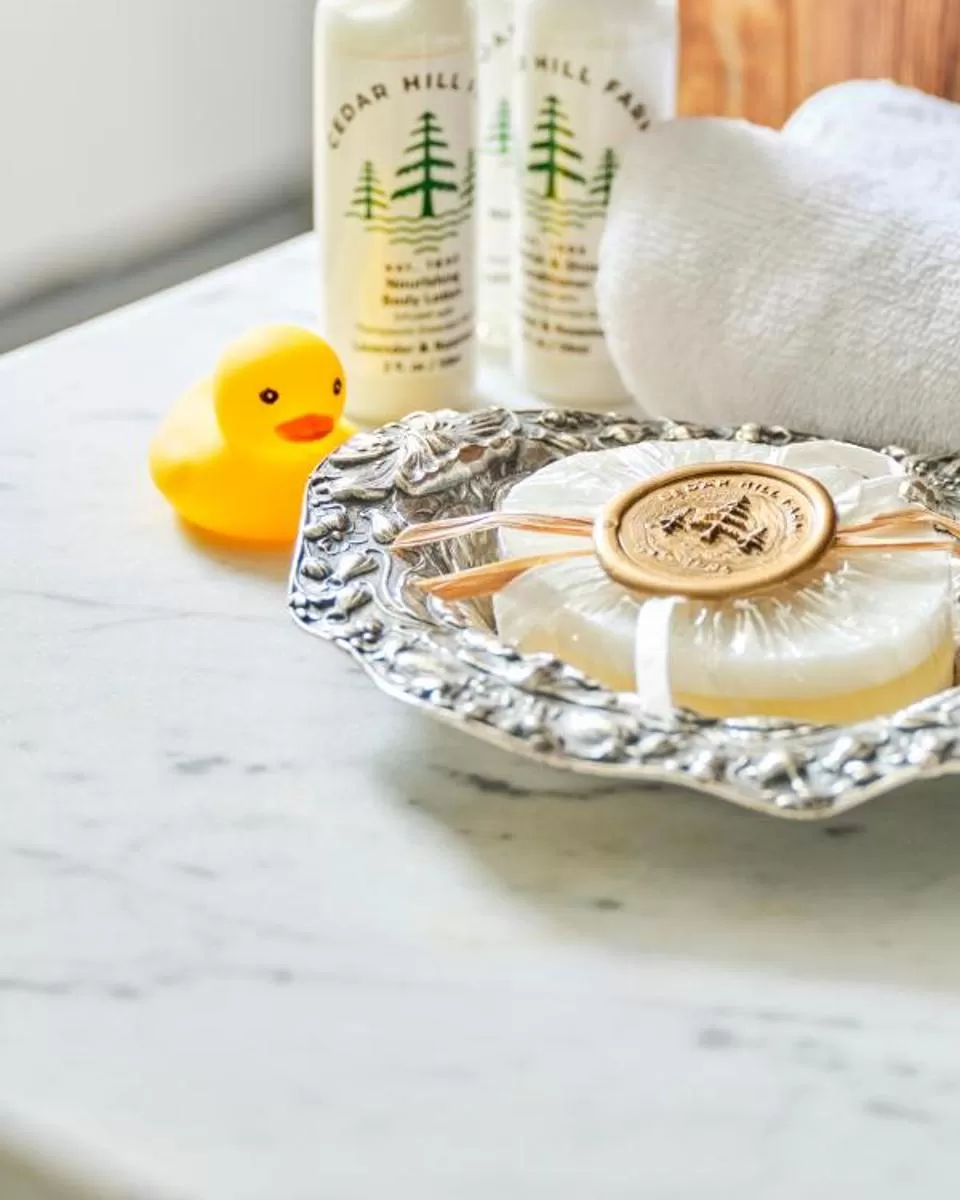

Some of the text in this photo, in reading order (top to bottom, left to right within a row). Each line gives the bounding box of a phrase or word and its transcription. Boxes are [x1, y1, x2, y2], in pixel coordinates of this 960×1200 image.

[534, 55, 590, 86] HILL
[327, 72, 460, 150] CEDAR HILL
